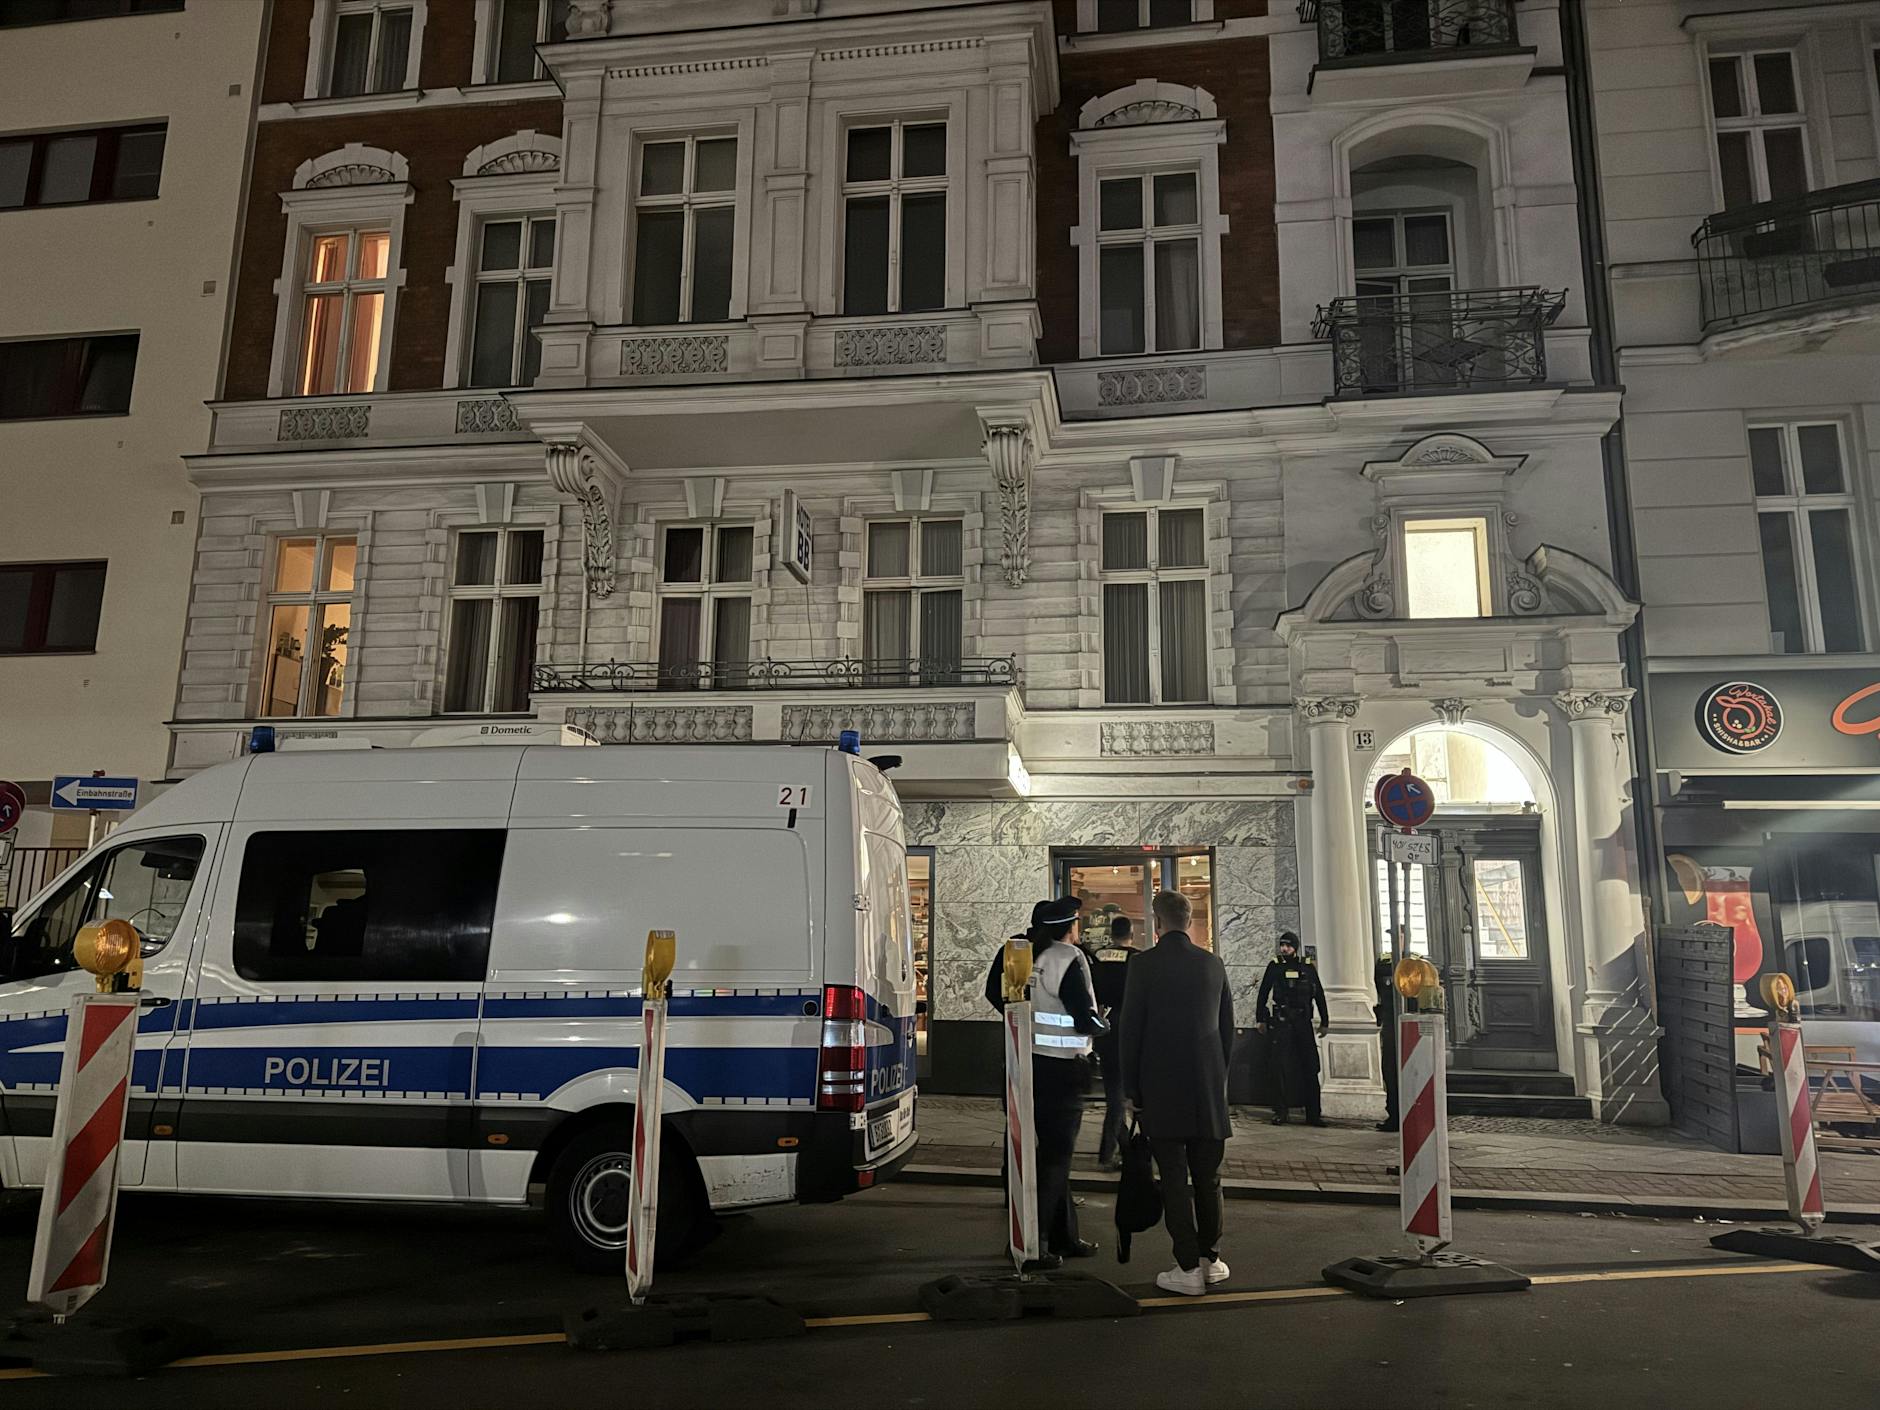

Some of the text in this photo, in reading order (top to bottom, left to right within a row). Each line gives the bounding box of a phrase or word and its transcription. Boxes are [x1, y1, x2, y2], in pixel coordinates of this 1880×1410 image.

[1728, 684, 1777, 725] Portakal
[490, 726, 533, 735] Dometic
[1356, 732, 1372, 745] 13
[1713, 722, 1762, 747] SHISHA&BAR
[76, 788, 133, 799] Einbahnstraße
[779, 786, 808, 806] 21
[264, 1057, 390, 1086] POLIZEI
